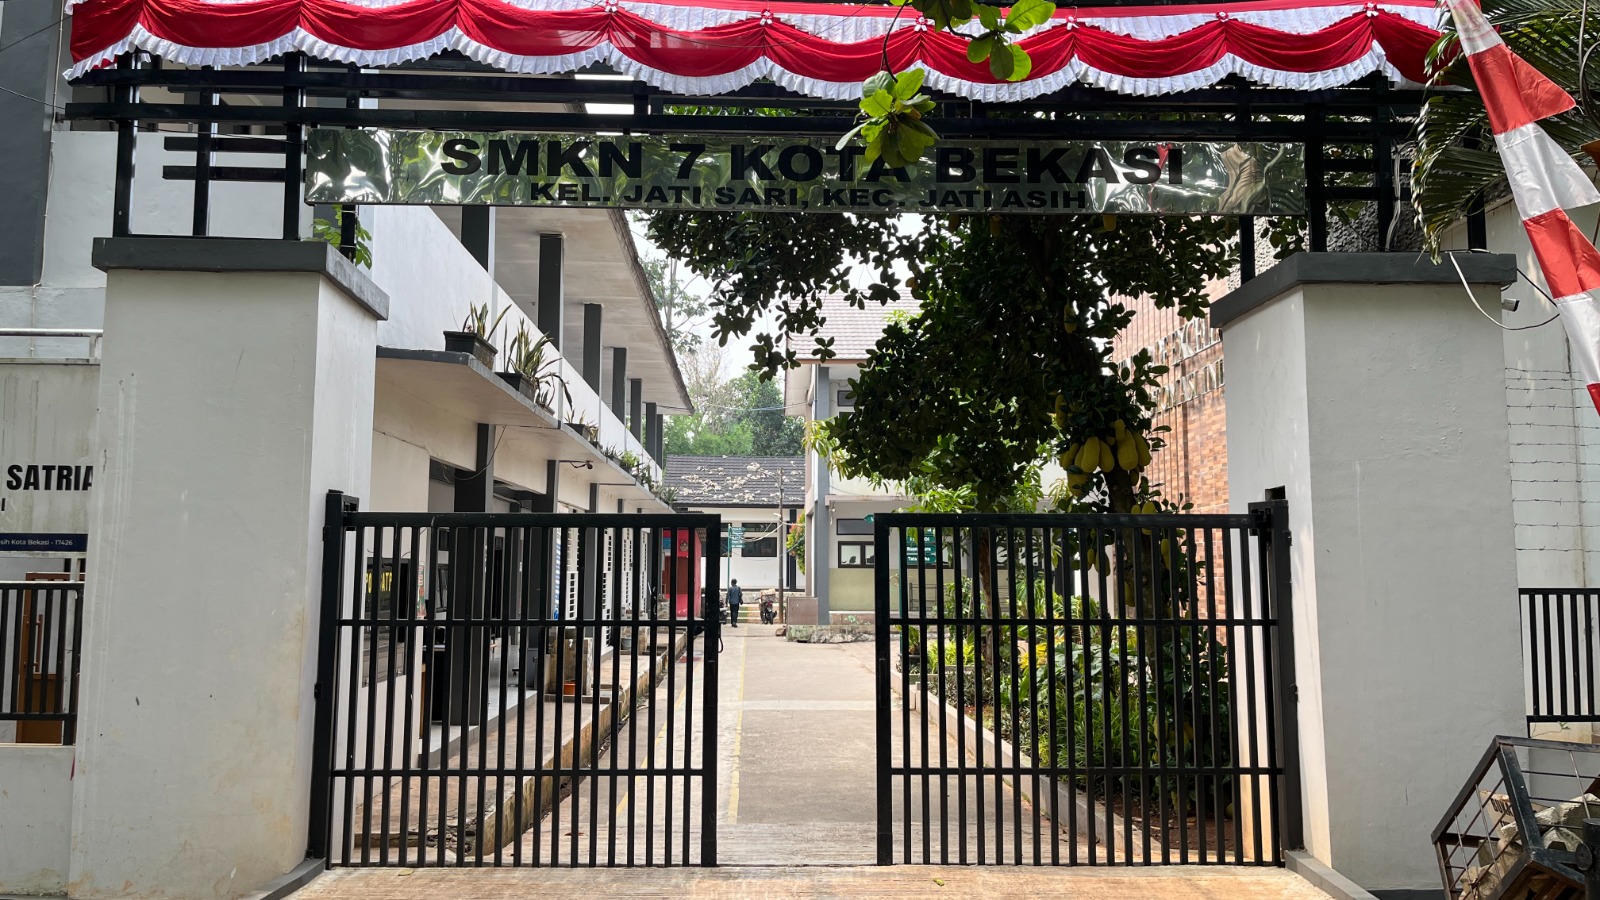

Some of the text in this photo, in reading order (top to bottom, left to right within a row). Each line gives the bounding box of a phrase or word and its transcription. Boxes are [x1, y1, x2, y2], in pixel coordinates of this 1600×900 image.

[441, 139, 1183, 185] SMKN 7 KOTA BEKASI
[531, 183, 1086, 210] KEL. JATI SARI, KEC. JATI ASIH
[6, 464, 94, 491] SATRIA
